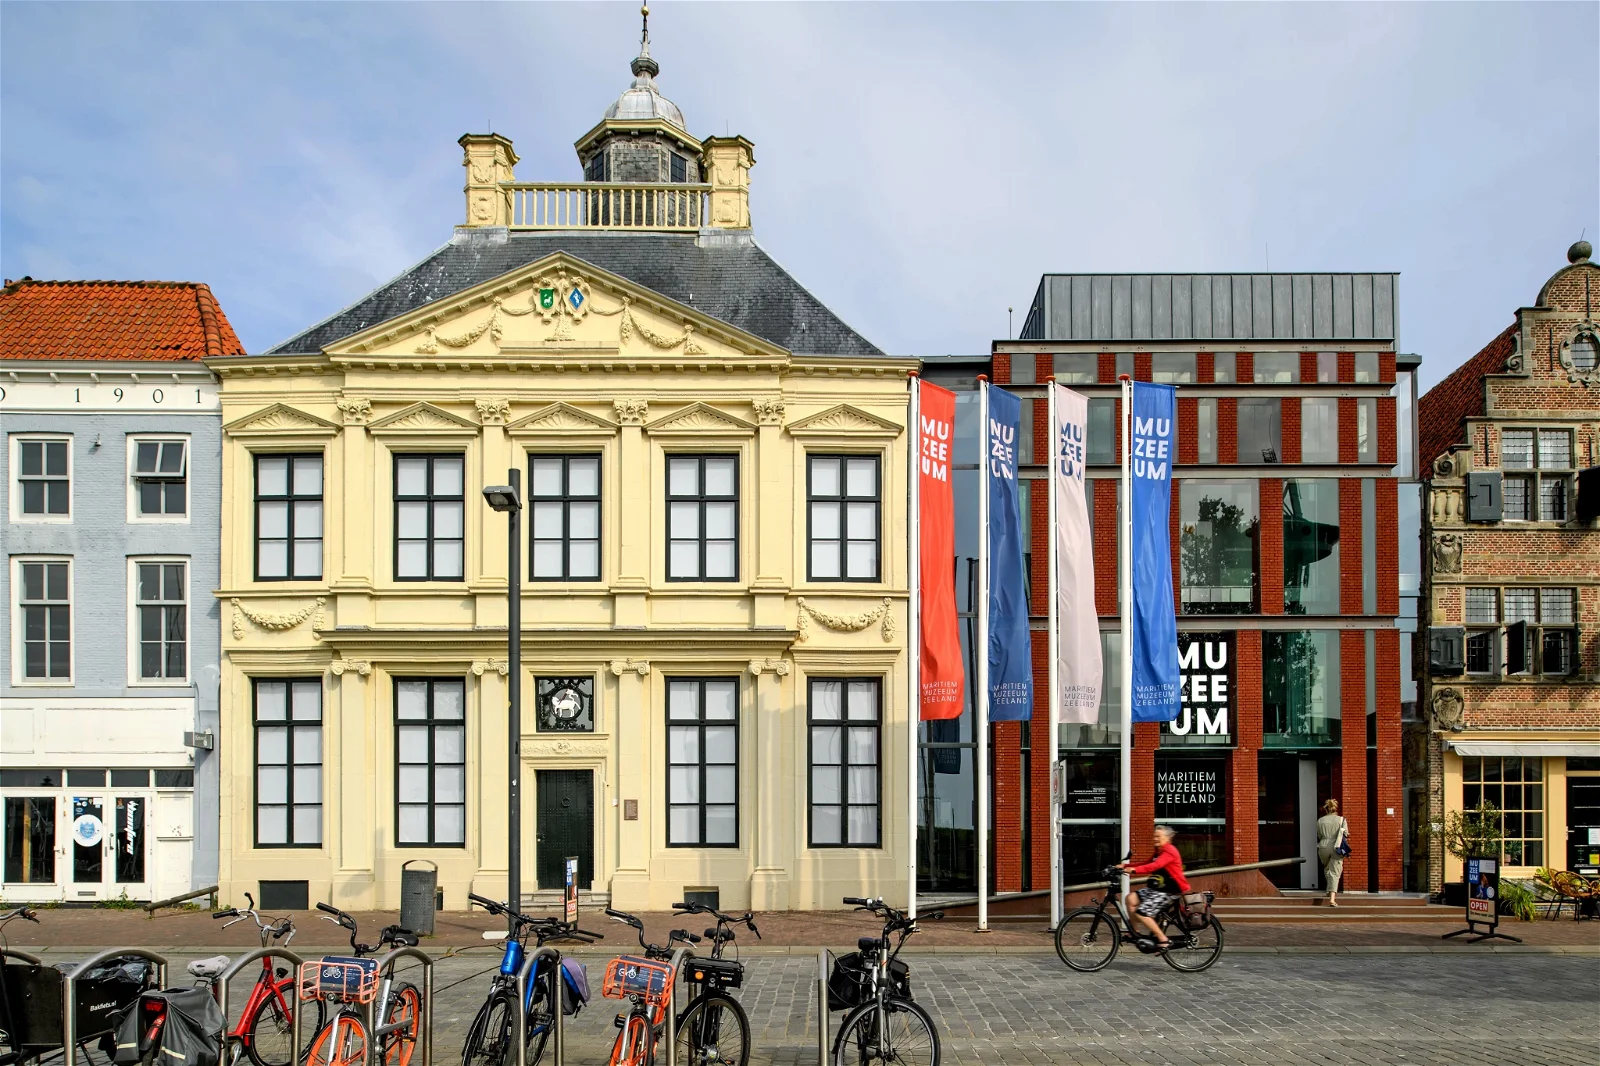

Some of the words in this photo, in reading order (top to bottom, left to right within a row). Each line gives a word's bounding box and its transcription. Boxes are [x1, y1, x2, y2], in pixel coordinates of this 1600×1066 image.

[74, 387, 202, 404] 1901
[921, 414, 949, 441] MU
[1060, 422, 1082, 443] MU
[1135, 416, 1170, 438] MU
[922, 436, 948, 462] ZEE
[991, 438, 1013, 465] ZEE
[1134, 437, 1169, 459] ZEE
[921, 455, 947, 482] UM
[1134, 458, 1167, 481] UM
[1177, 641, 1228, 670] MU
[922, 681, 958, 690] MARITIEM
[923, 688, 958, 696] MUZEEUM
[1136, 683, 1176, 692] MARITIEM
[923, 695, 957, 704] ZEELAND
[1136, 690, 1176, 699] MUZEEUM
[1136, 698, 1175, 707] ZEELAND
[1169, 707, 1229, 736] UM
[1157, 771, 1216, 782] MARITIEM
[1157, 782, 1216, 793] MUZEEUM
[1158, 793, 1216, 804] ZEELAND
[1470, 901, 1488, 910] OPEN
